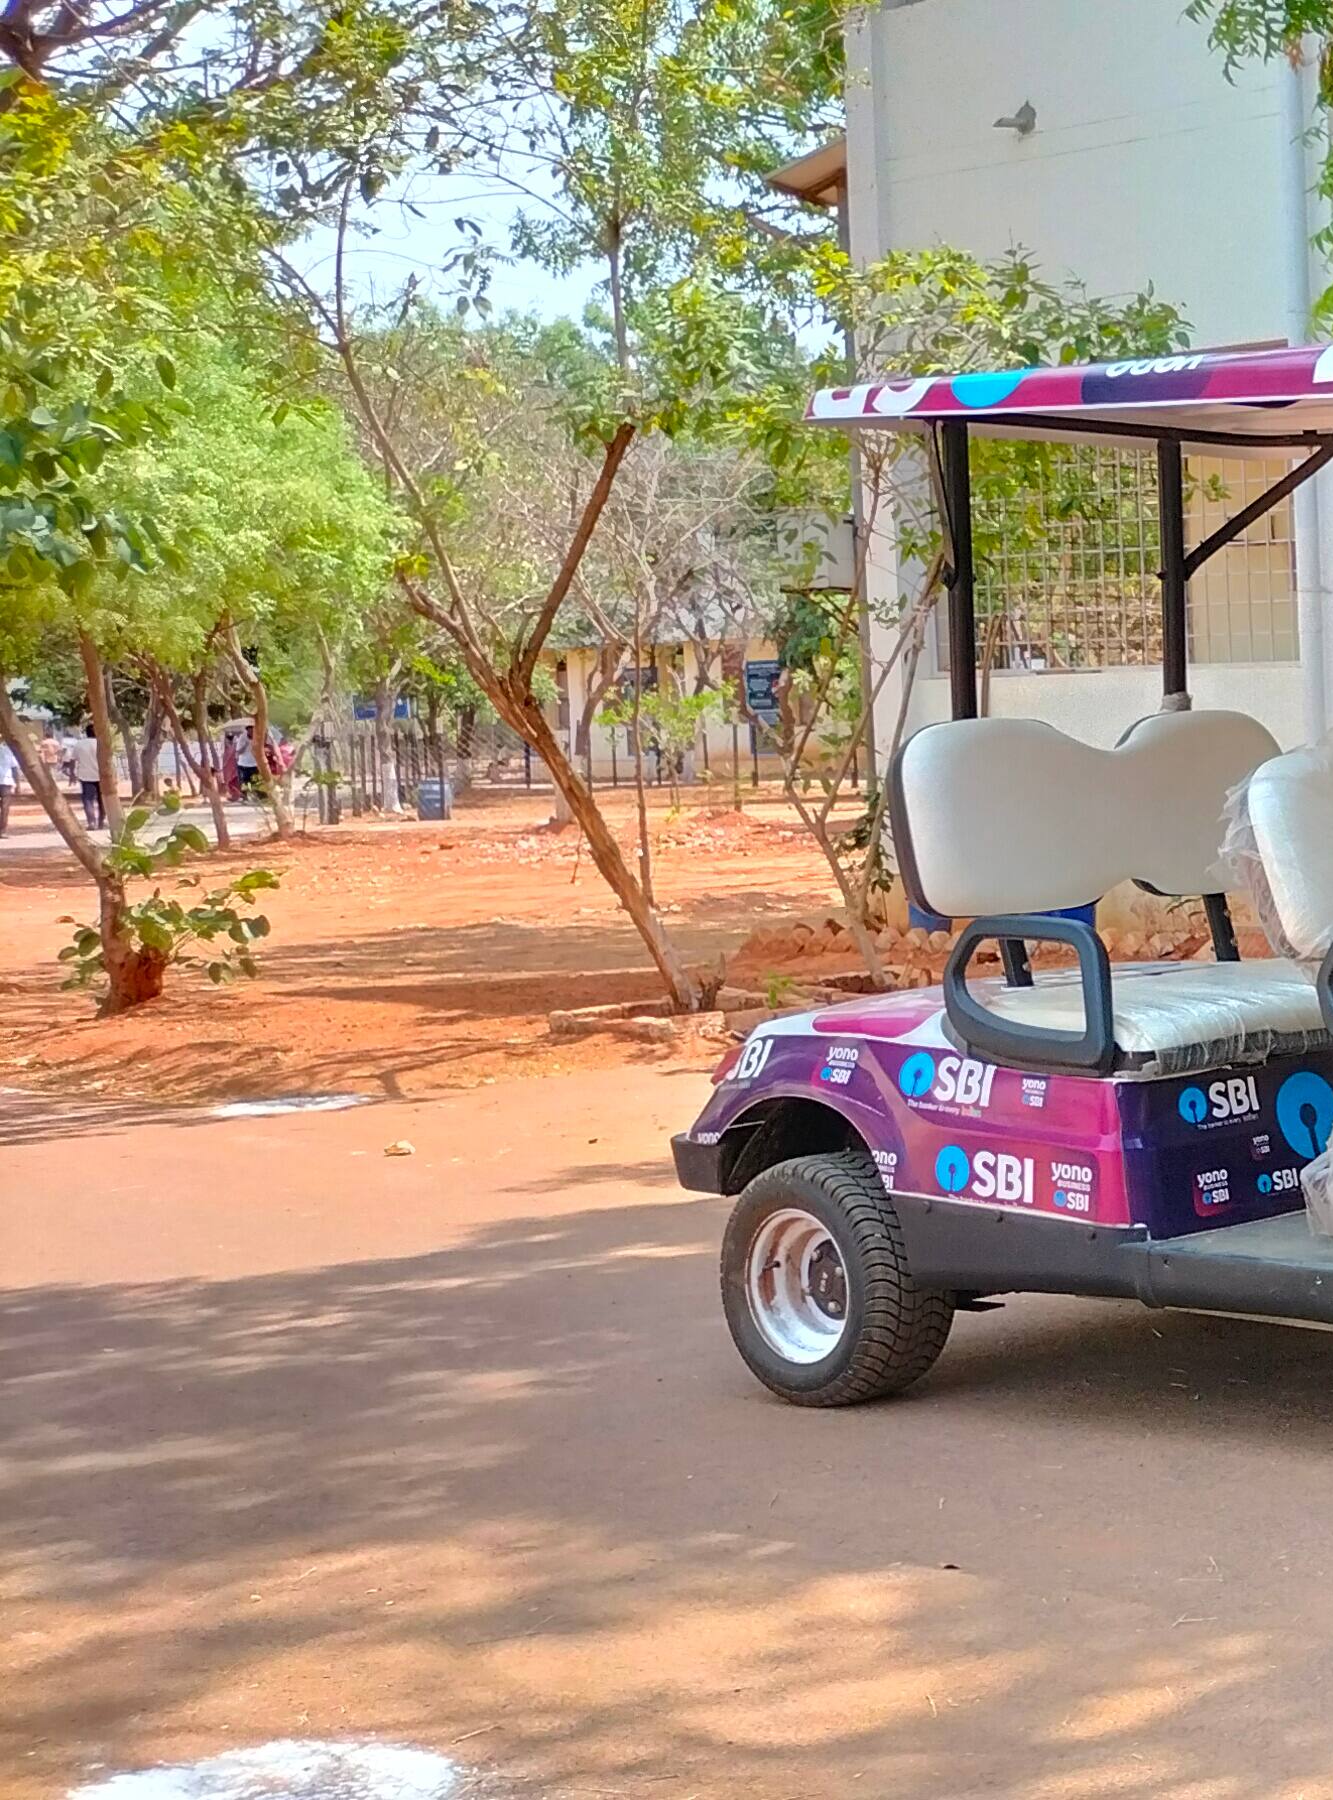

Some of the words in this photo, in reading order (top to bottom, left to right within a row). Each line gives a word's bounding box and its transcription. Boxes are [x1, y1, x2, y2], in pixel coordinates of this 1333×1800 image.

[826, 1046, 859, 1062] yono
[831, 1067, 852, 1084] SBI
[933, 1056, 998, 1107] SBI
[1022, 1078, 1047, 1090] yono
[1029, 1095, 1044, 1108] SBI
[1208, 1076, 1260, 1118] SBI
[971, 1151, 1035, 1204] SBI
[1051, 1162, 1093, 1183] yono
[1197, 1168, 1229, 1188] yono
[1272, 1167, 1299, 1191] SBI
[1066, 1192, 1090, 1212] SBI
[1211, 1188, 1230, 1204] SBI
